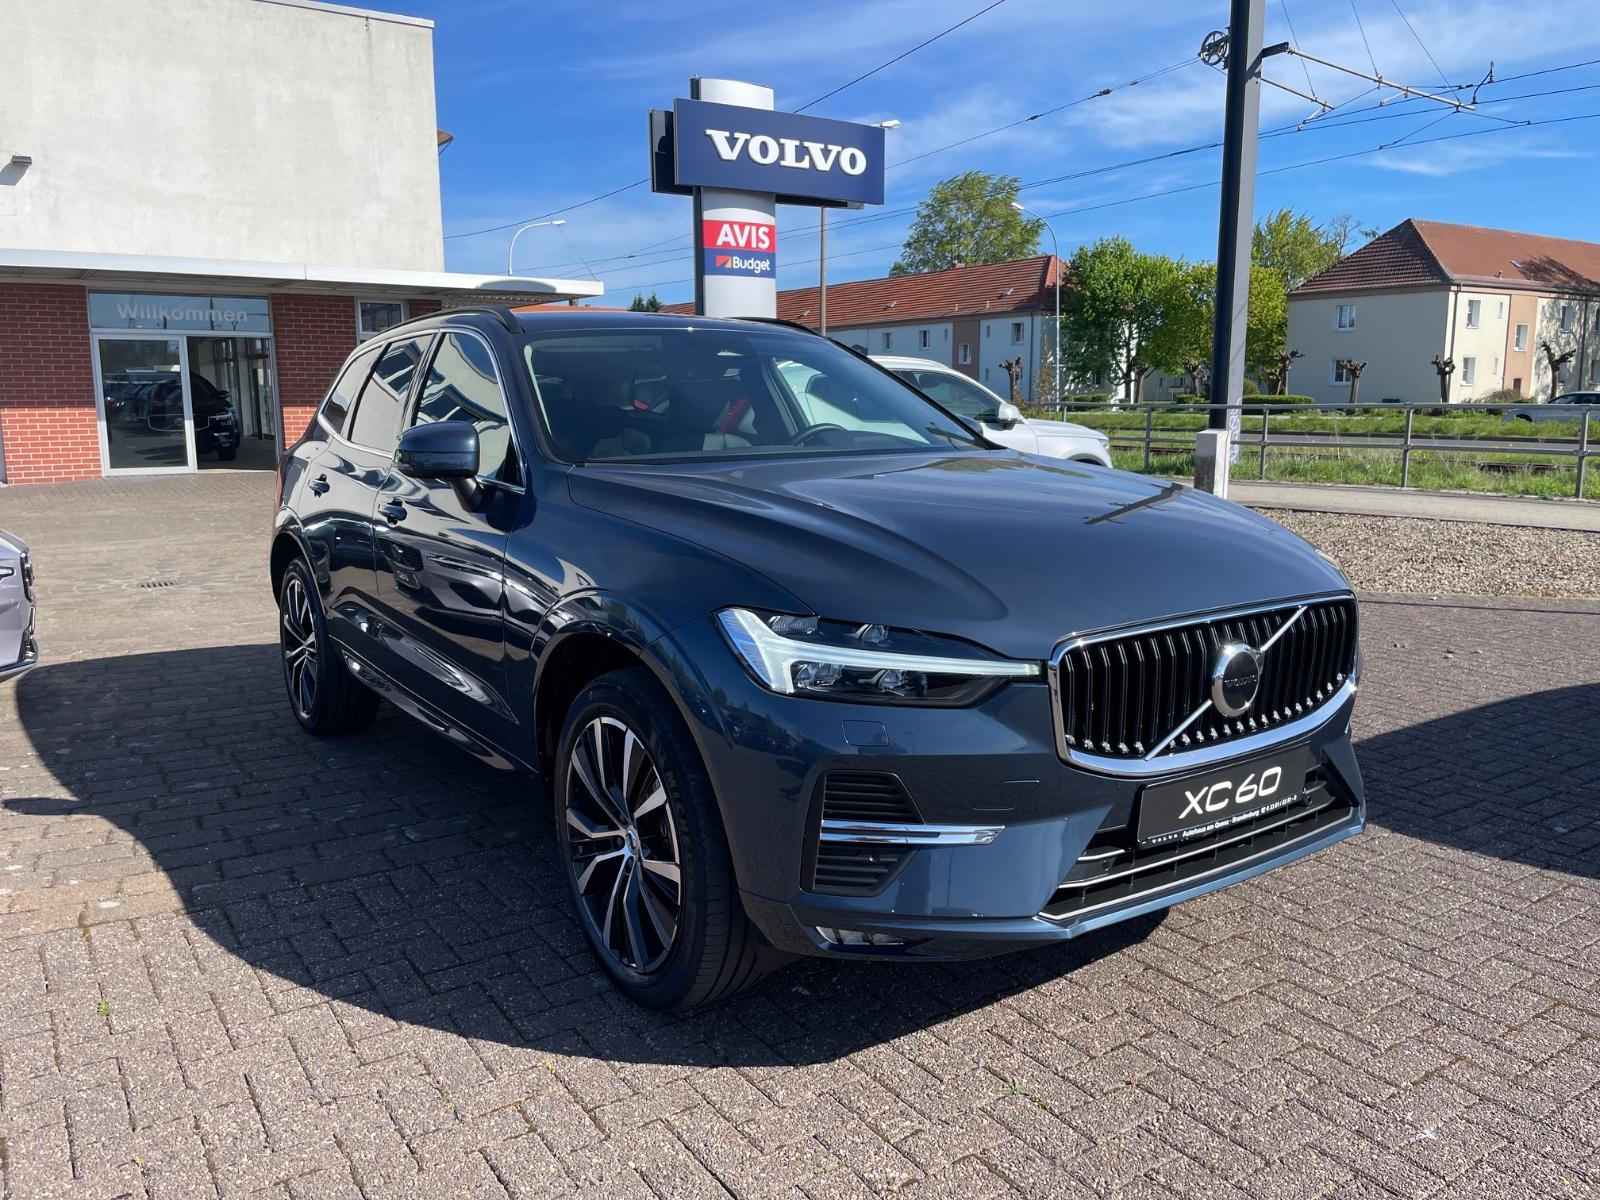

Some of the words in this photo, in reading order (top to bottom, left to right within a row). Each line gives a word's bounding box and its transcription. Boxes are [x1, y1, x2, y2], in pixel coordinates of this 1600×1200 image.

[705, 129, 866, 176] VOLVO
[716, 223, 770, 250] AVIS
[732, 256, 770, 274] Budget
[116, 303, 248, 322] Willkommen
